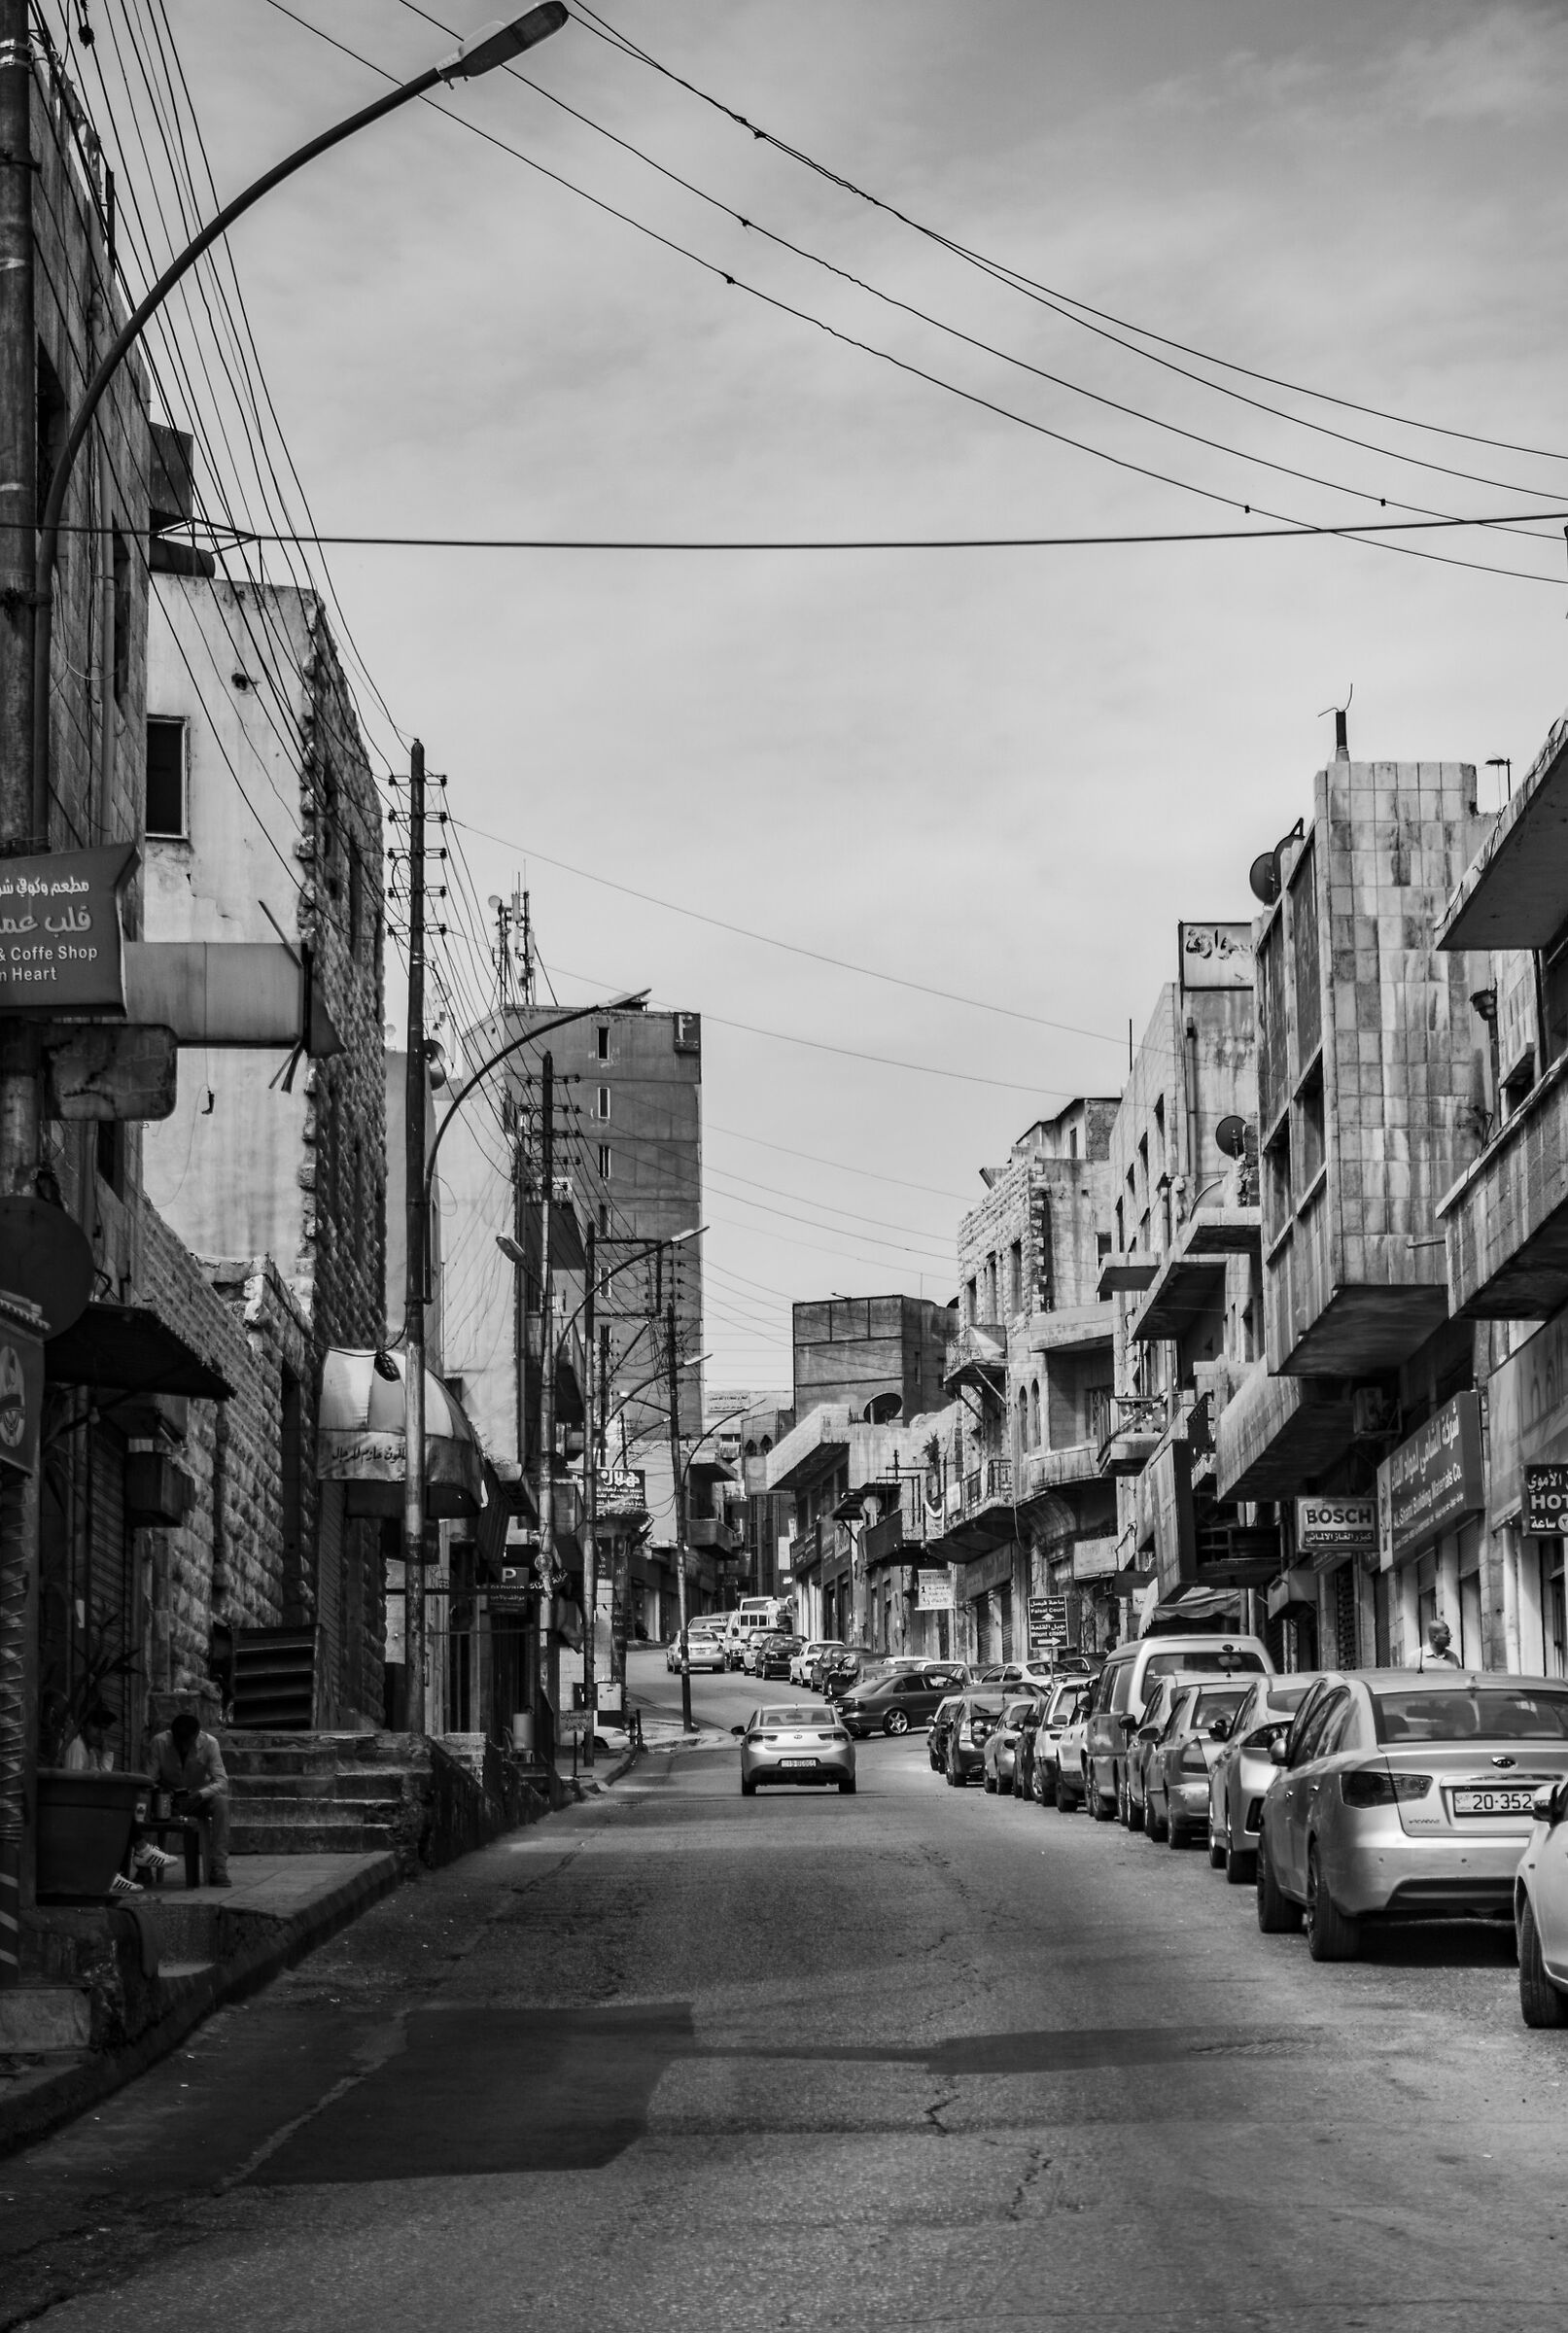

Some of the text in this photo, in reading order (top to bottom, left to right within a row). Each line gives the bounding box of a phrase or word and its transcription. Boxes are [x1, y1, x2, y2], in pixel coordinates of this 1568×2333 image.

[17, 877, 49, 897] وكوفي
[51, 877, 89, 896] مطعم
[45, 905, 91, 938] قلب
[11, 947, 53, 961] Coffe
[58, 946, 97, 961] Shop
[12, 967, 57, 981] Heart
[1527, 1469, 1562, 1493] الأموي
[1306, 1509, 1372, 1524] BOSCH
[1530, 1516, 1555, 1529] ساعة
[503, 1568, 516, 1583] P
